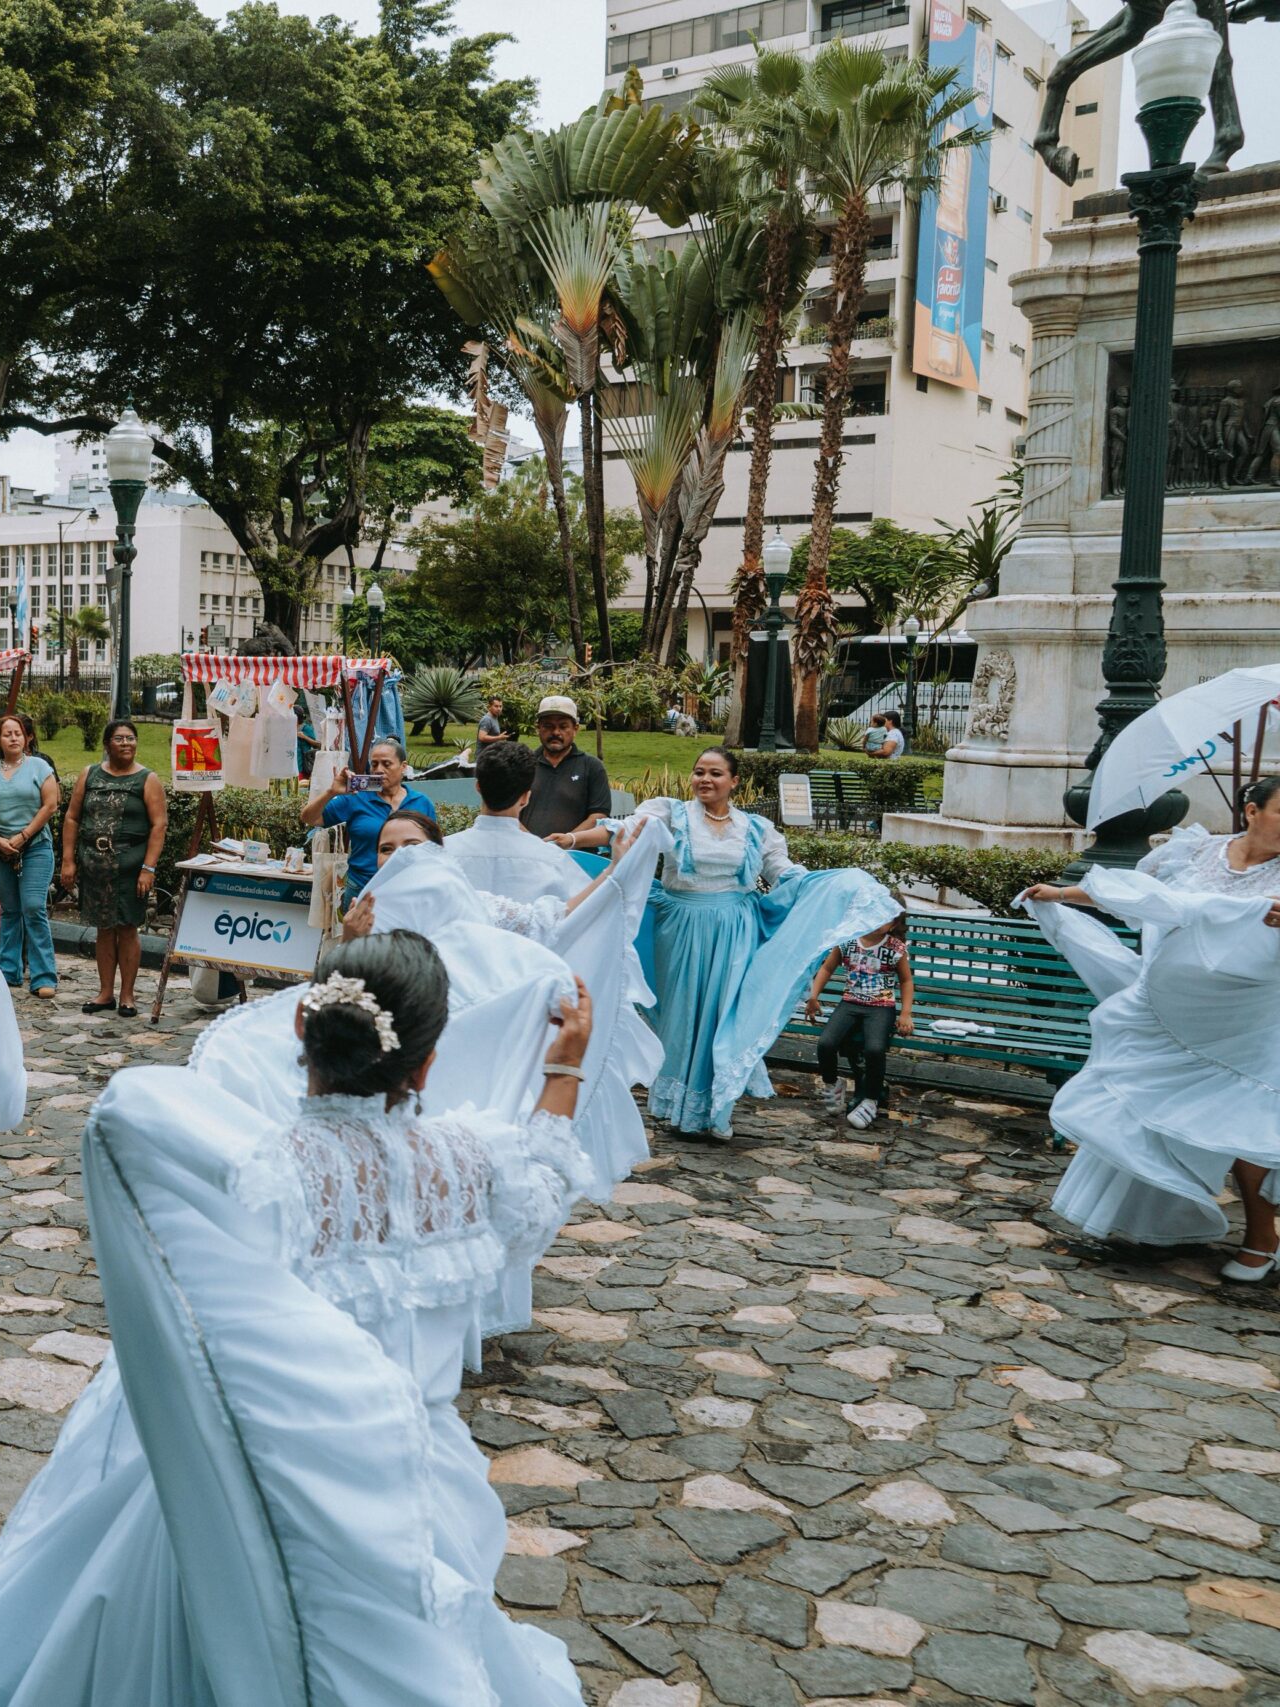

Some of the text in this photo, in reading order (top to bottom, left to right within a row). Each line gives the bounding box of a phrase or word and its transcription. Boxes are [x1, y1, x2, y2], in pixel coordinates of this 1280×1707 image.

[945, 269, 954, 282] La
[226, 883, 235, 891] La
[235, 885, 256, 895] Ciudad
